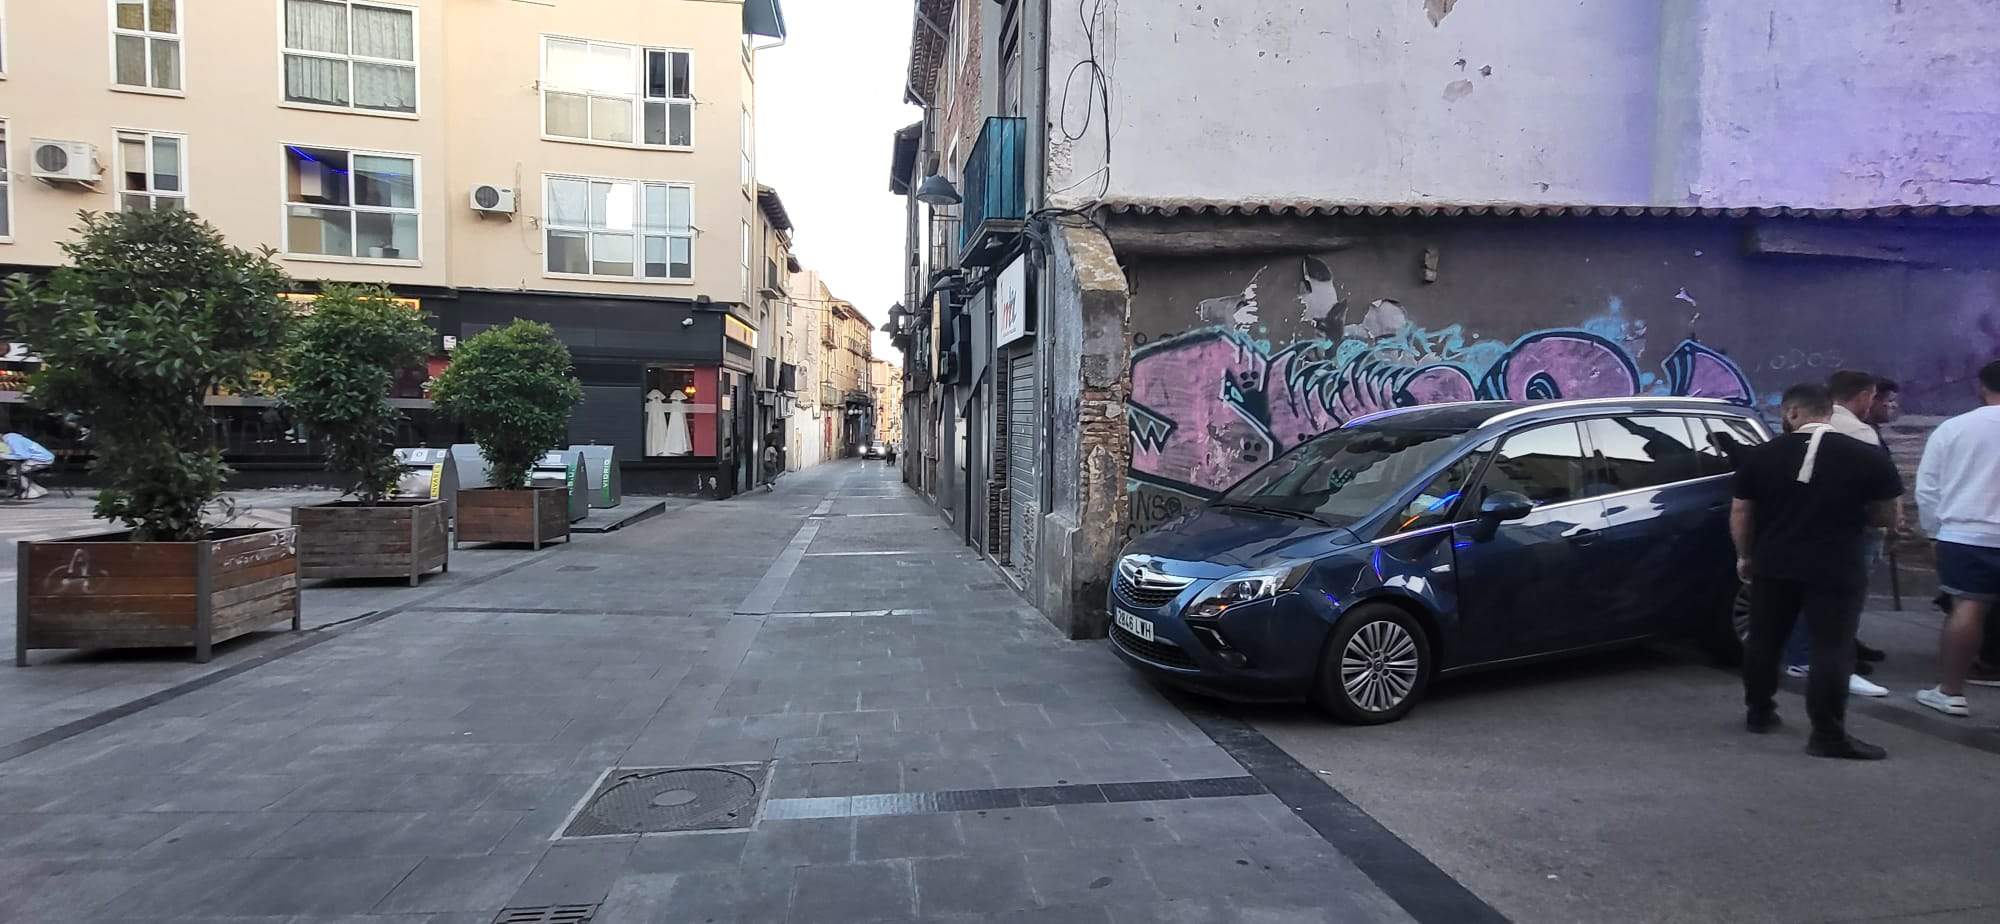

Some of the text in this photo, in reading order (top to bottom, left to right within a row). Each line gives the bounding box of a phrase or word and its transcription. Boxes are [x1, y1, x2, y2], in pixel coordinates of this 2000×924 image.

[602, 459, 610, 488] VIDRIO
[1117, 609, 1151, 639] 2846 LWH
